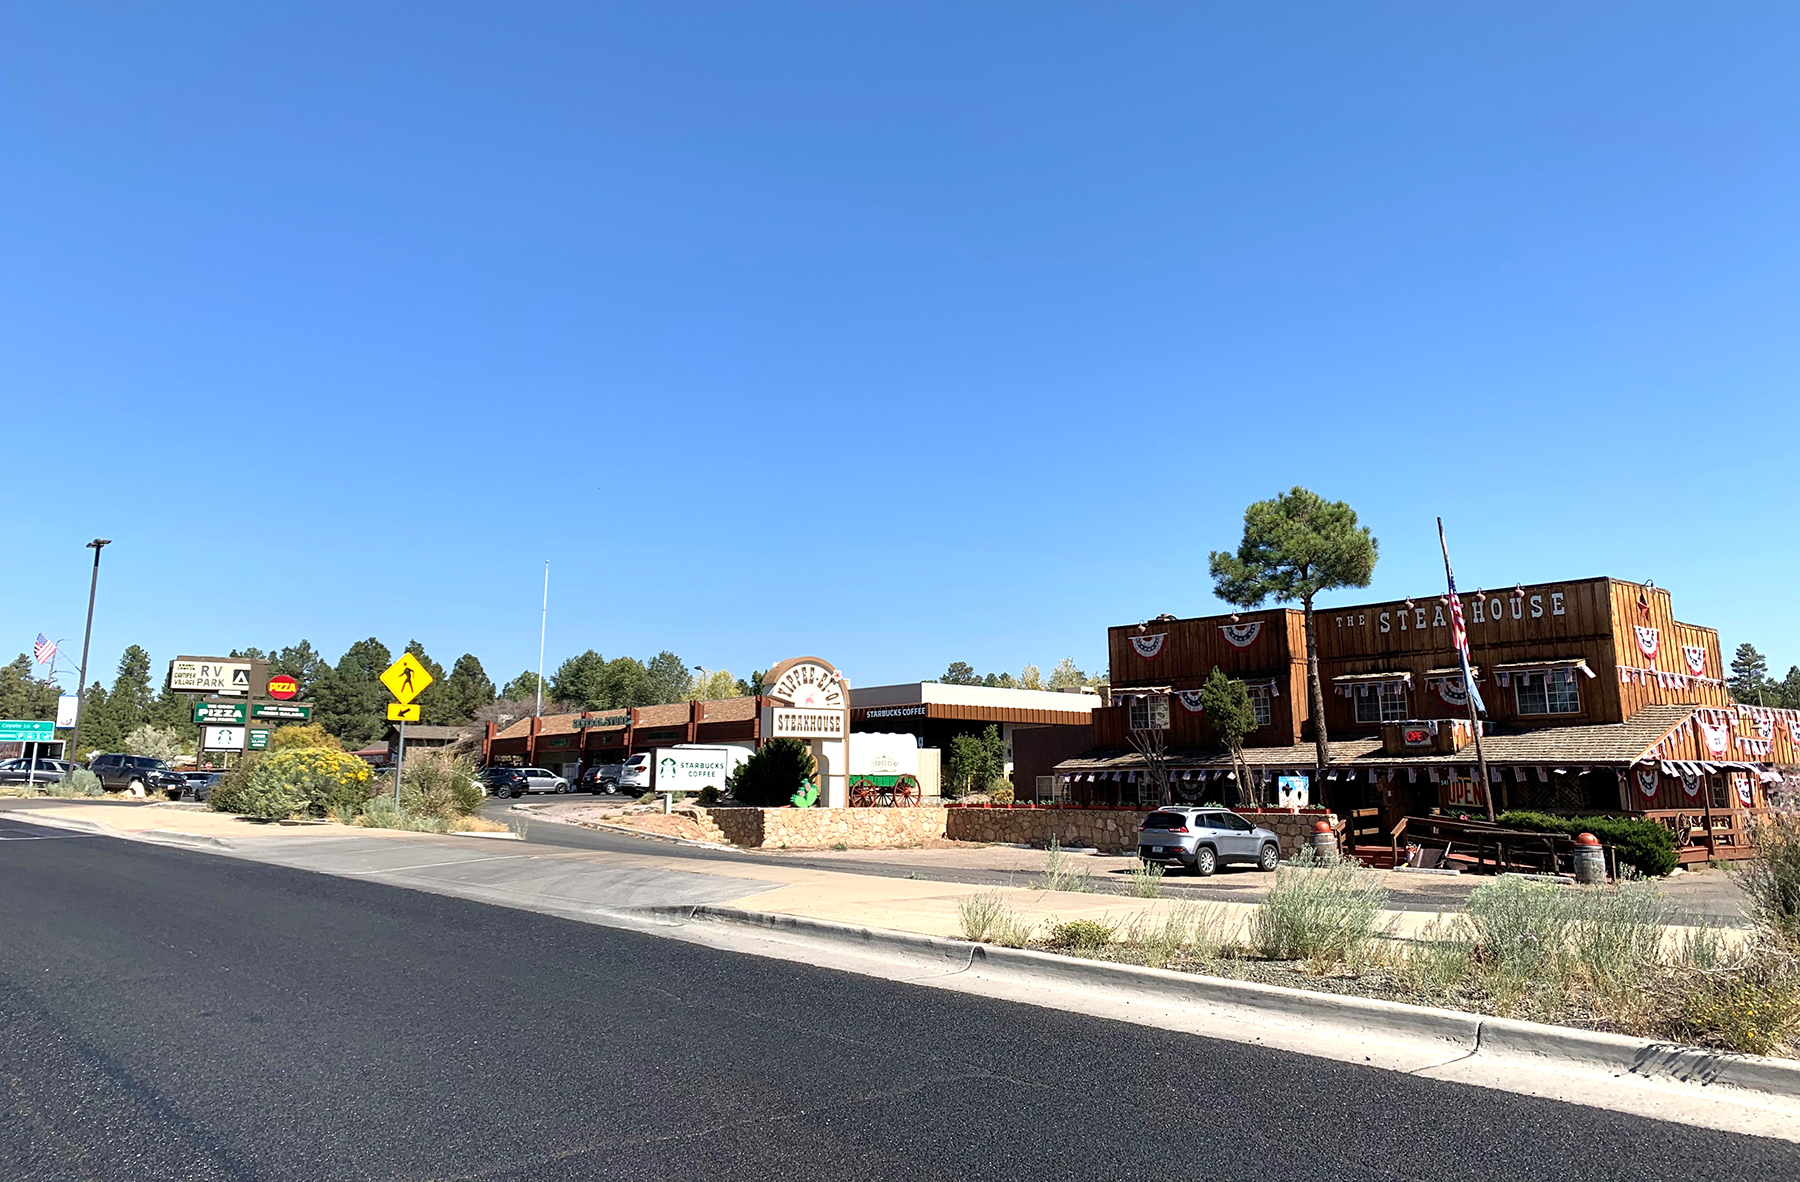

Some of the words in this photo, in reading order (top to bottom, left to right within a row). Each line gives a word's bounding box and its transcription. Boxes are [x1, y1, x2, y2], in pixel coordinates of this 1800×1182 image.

[1336, 614, 1365, 628] THE
[1380, 592, 1565, 634] STEAHOUSE
[196, 678, 225, 688] PARK
[269, 682, 296, 692] PIZZA
[198, 709, 243, 718] PIZZA
[867, 708, 901, 718] STARBUCKS
[902, 707, 926, 716] COFFEE
[778, 714, 841, 733] STEAKHOUSE
[680, 761, 724, 770] STARBUCKS
